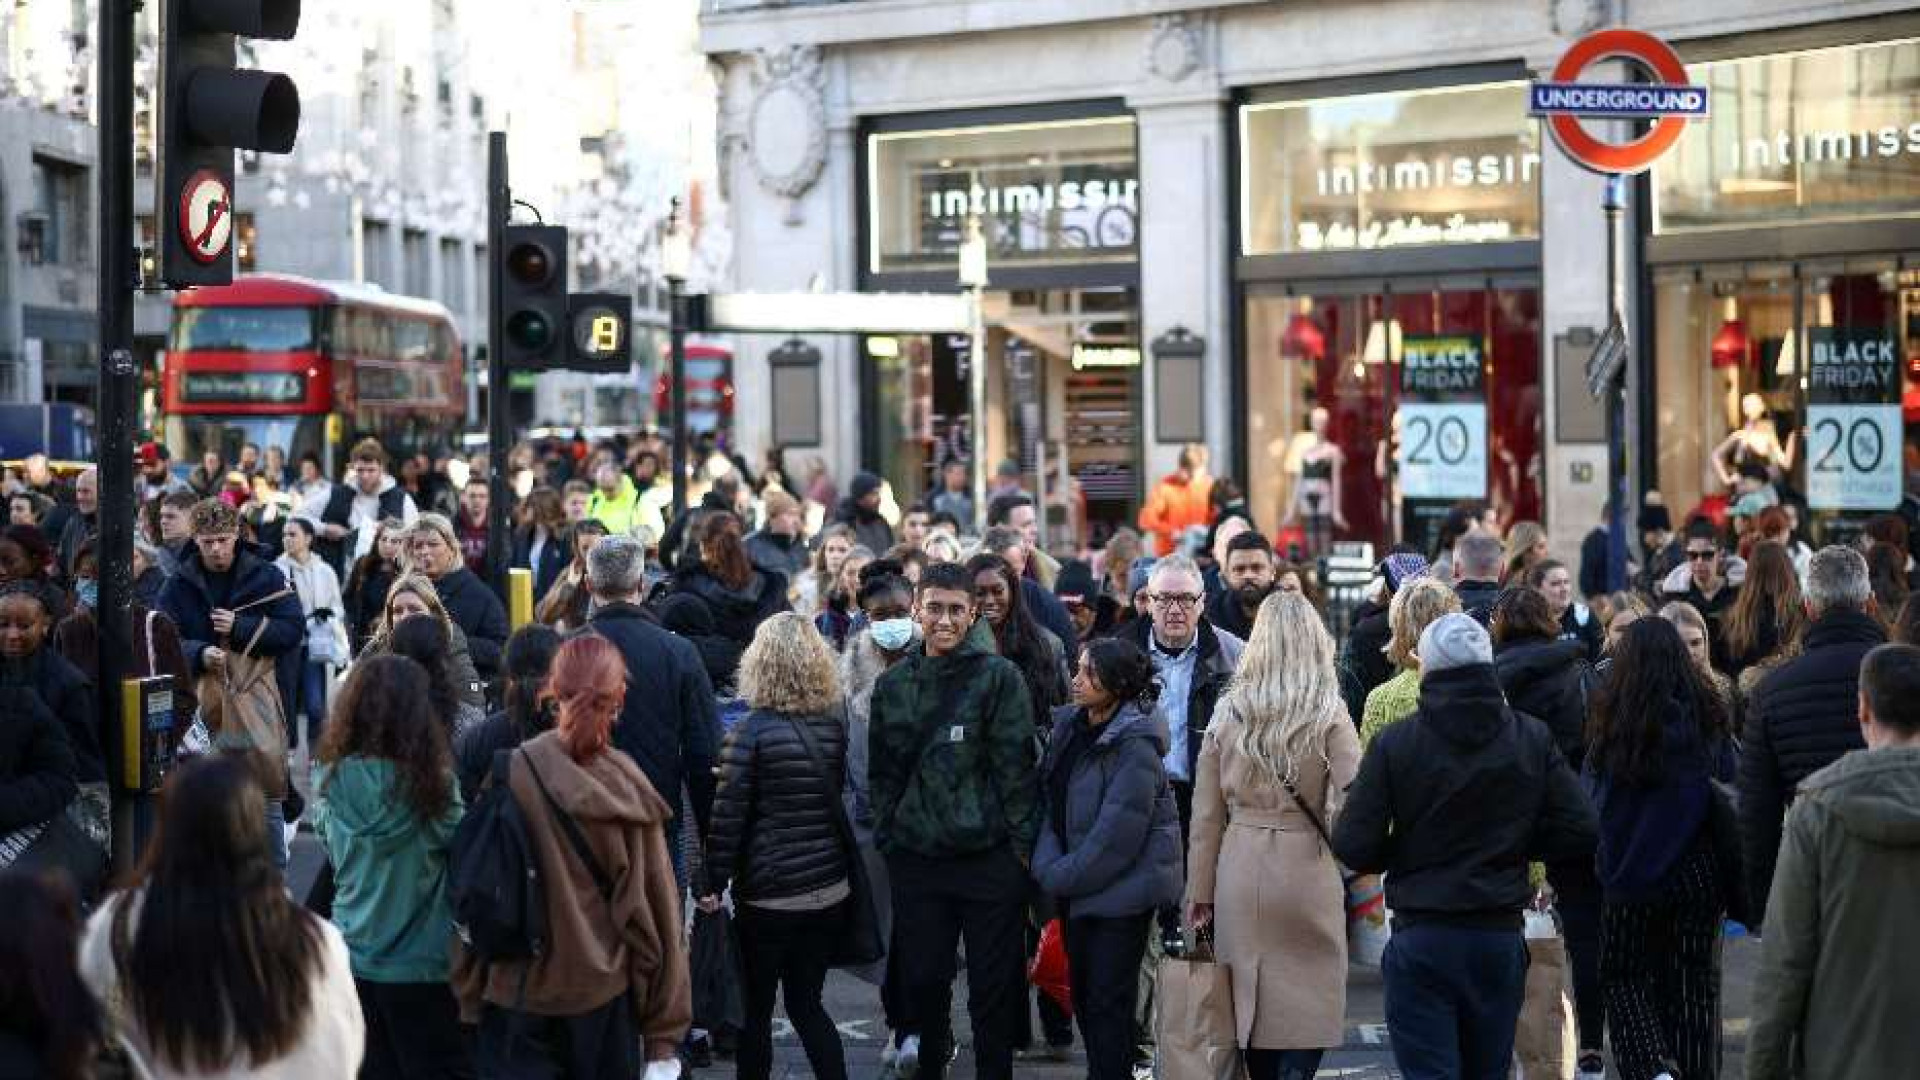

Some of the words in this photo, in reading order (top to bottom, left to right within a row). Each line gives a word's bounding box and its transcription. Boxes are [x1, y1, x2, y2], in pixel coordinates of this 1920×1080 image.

[1538, 88, 1702, 110] UNDERGROUND
[1405, 346, 1480, 368] BLACK
[1812, 341, 1894, 363] BLACK
[1403, 368, 1478, 390] FRIDAY
[1811, 364, 1894, 387] FRIDAY
